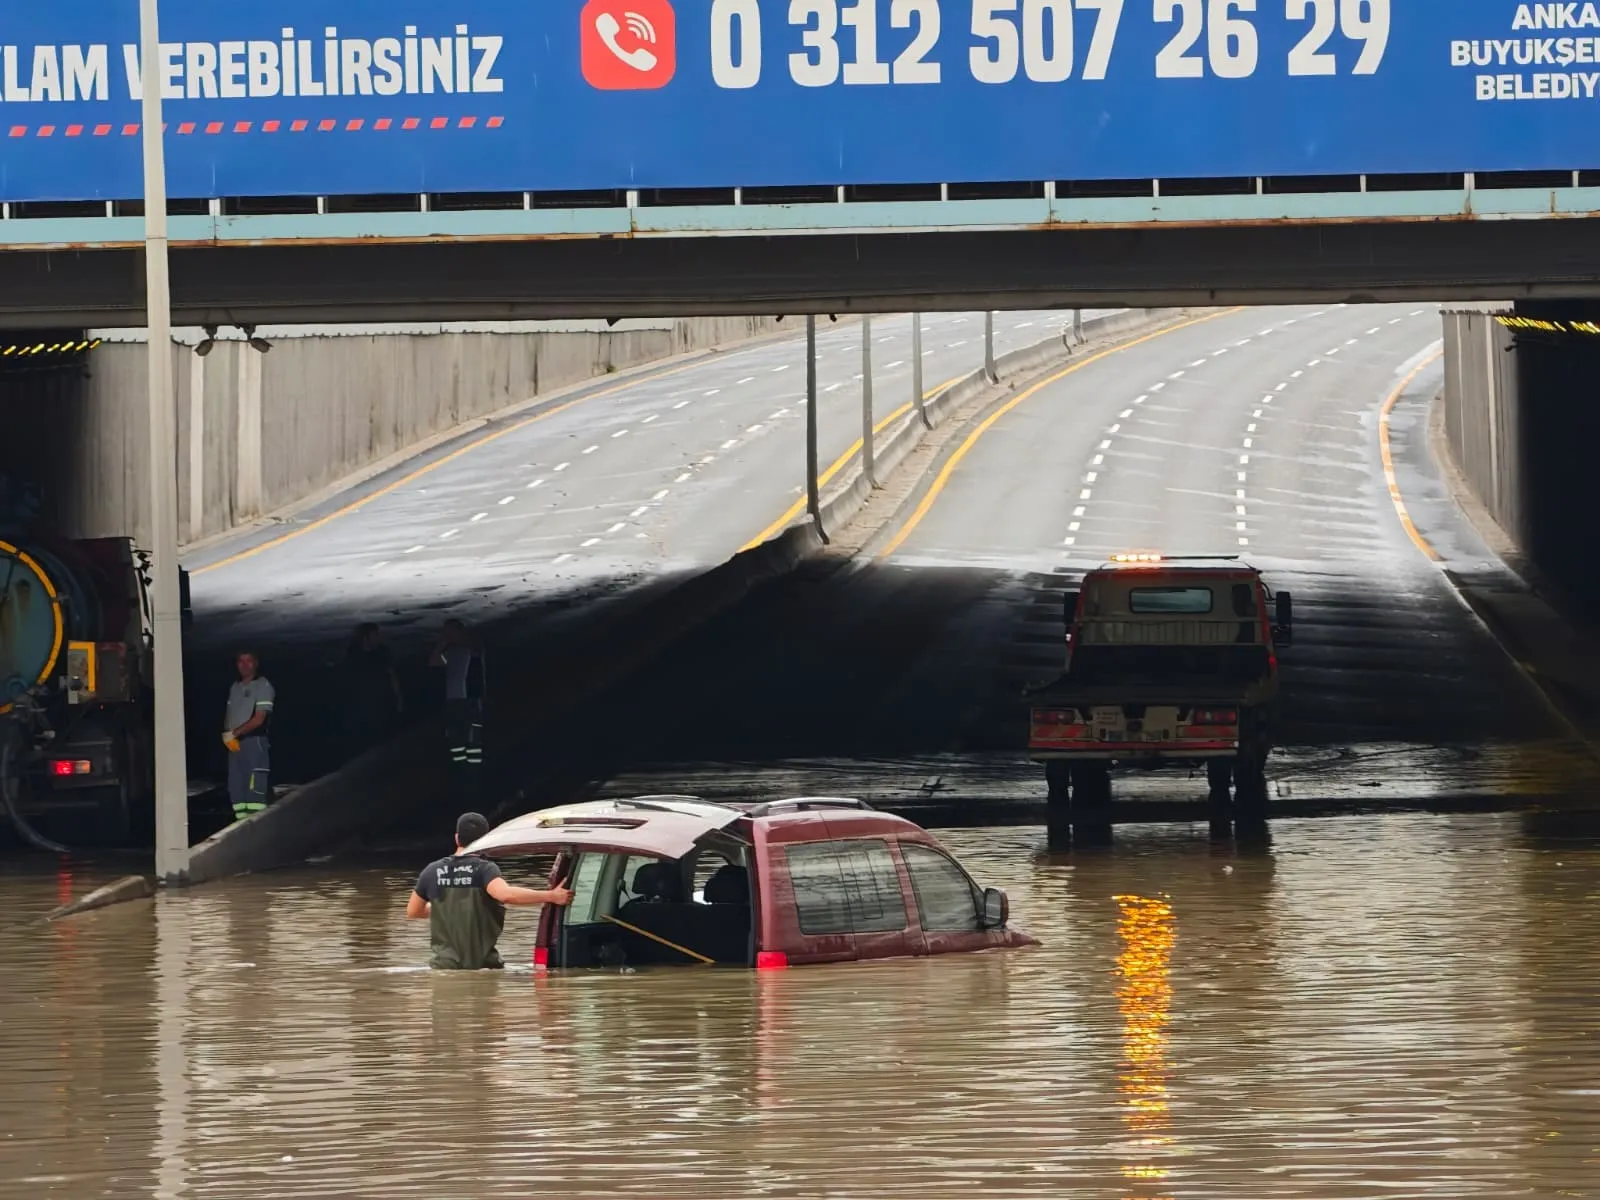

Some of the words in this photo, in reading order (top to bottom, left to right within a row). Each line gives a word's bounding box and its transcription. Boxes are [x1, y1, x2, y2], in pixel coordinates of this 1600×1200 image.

[0, 44, 109, 102] LAM
[710, 0, 762, 89] 0
[787, 0, 941, 88] 312
[969, 0, 1125, 84] 507
[1153, 0, 1259, 79] 26
[1285, 0, 1391, 76] 29
